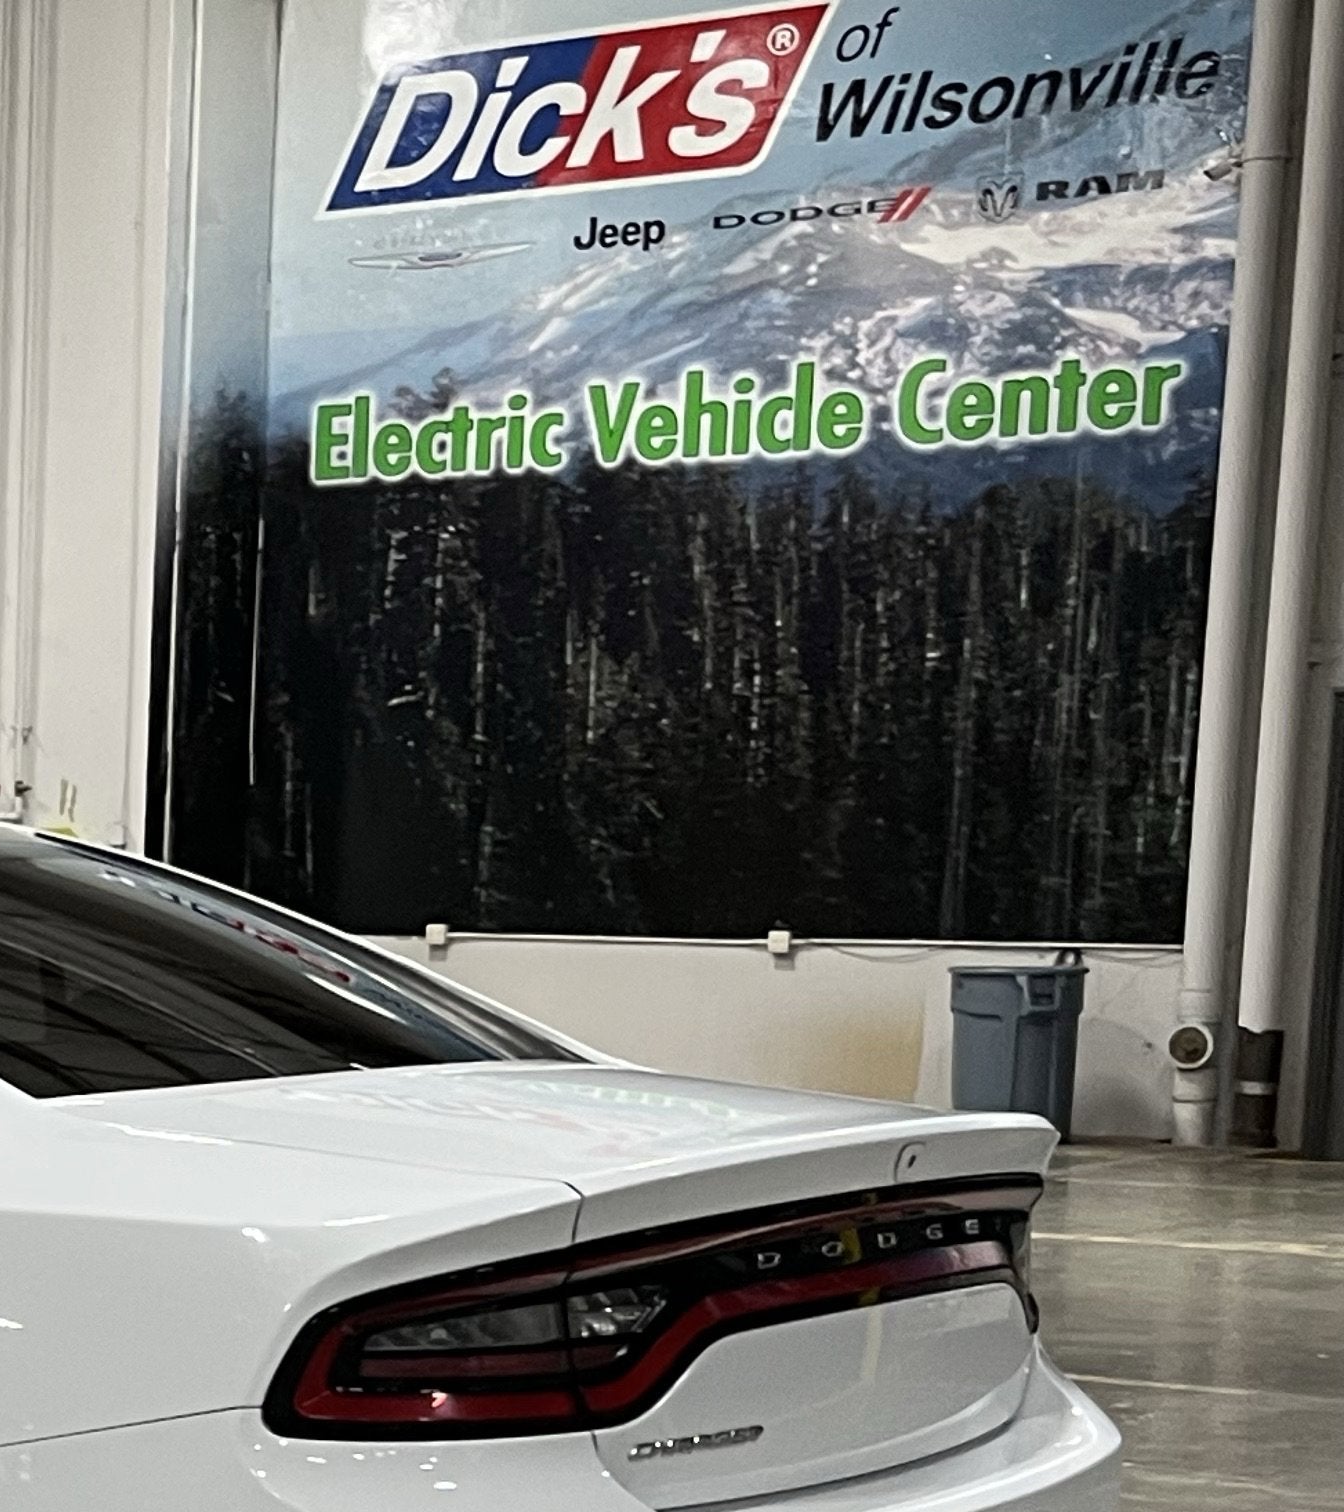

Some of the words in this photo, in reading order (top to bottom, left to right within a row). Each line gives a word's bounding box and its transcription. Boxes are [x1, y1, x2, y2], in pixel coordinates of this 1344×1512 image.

[836, 6, 900, 62] of
[353, 29, 771, 193] Dick's
[815, 37, 1222, 143] Wilsonville
[1036, 169, 1165, 201] RAM
[572, 216, 666, 251] Jeep
[713, 197, 900, 230] DODGE
[314, 394, 564, 483] Electric
[590, 362, 864, 465] Vehicle
[898, 358, 1182, 446] Center
[757, 1218, 980, 1270] DODGE
